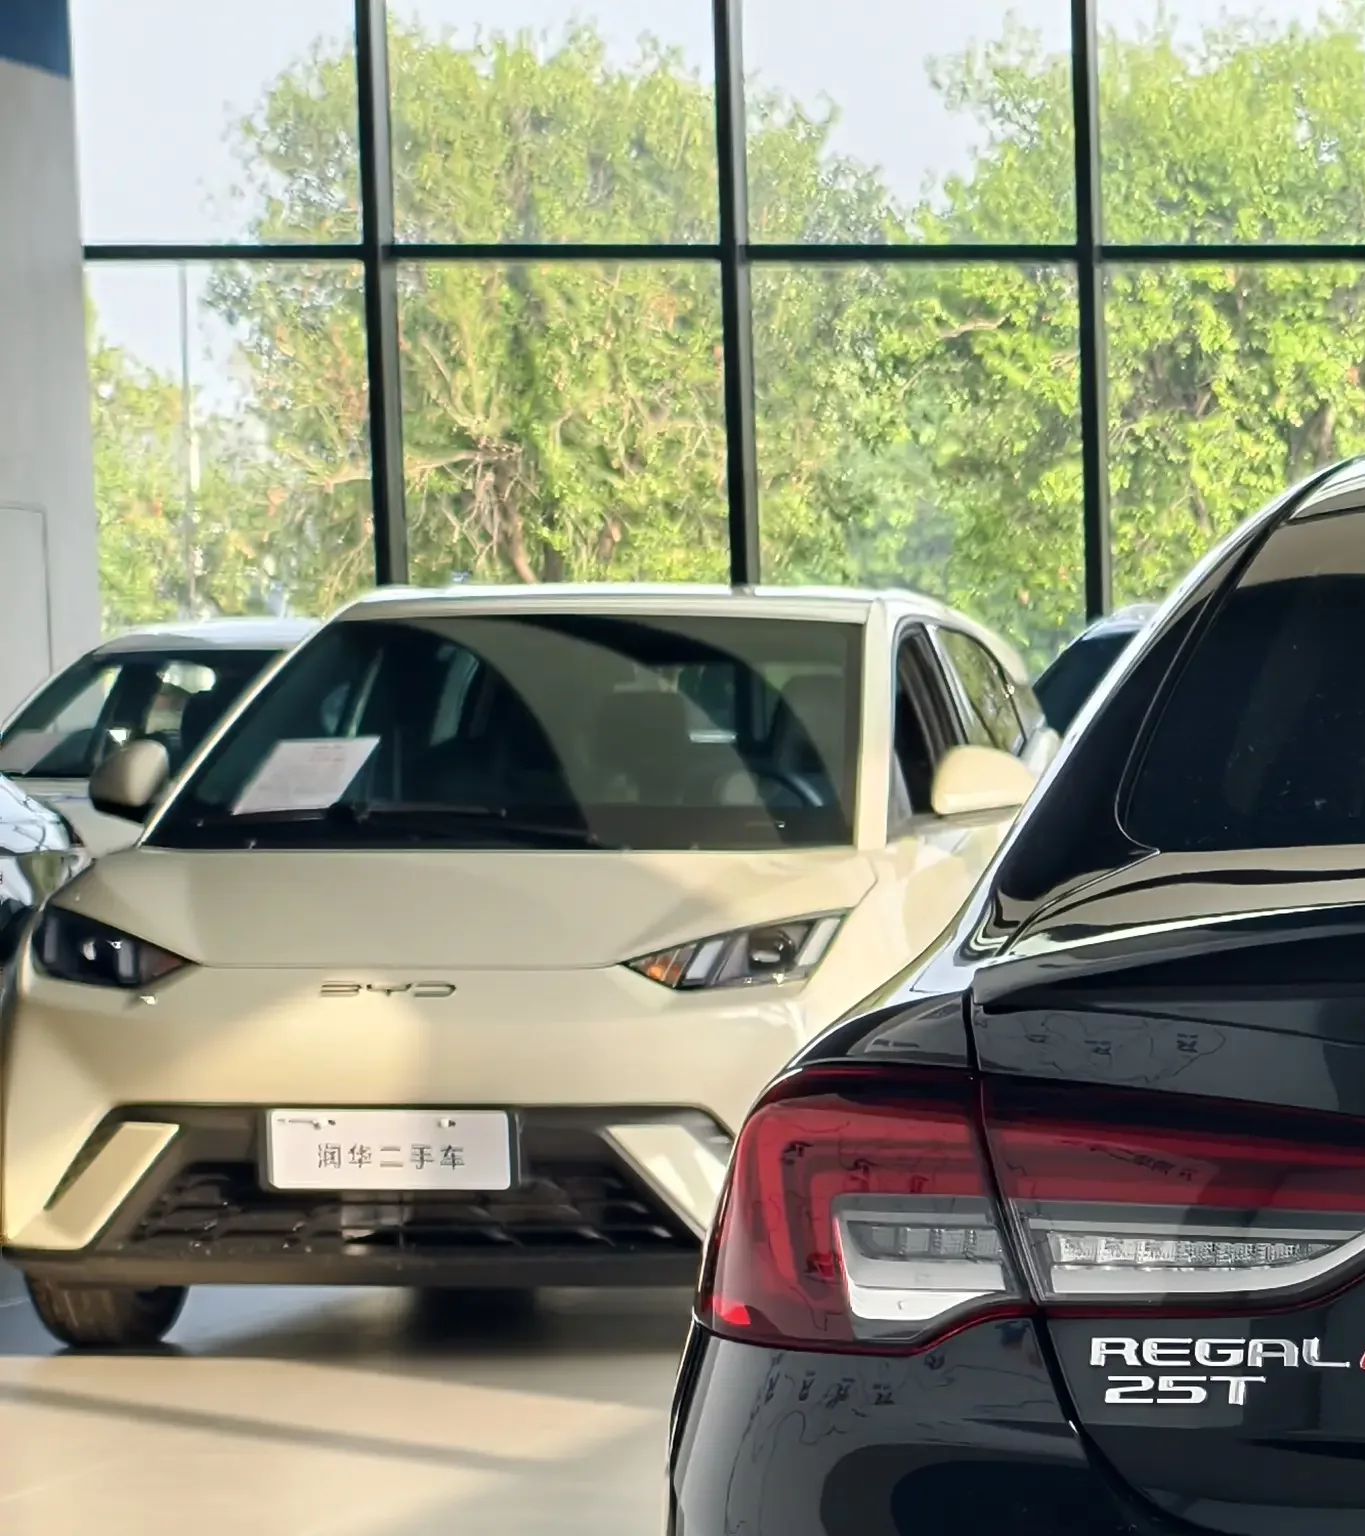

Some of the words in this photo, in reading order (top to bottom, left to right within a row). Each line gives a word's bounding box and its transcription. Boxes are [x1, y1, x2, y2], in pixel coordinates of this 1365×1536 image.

[317, 1142, 466, 1170] 润华二手车
[1089, 1336, 1351, 1369] REGAL
[1104, 1375, 1267, 1406] 25T
